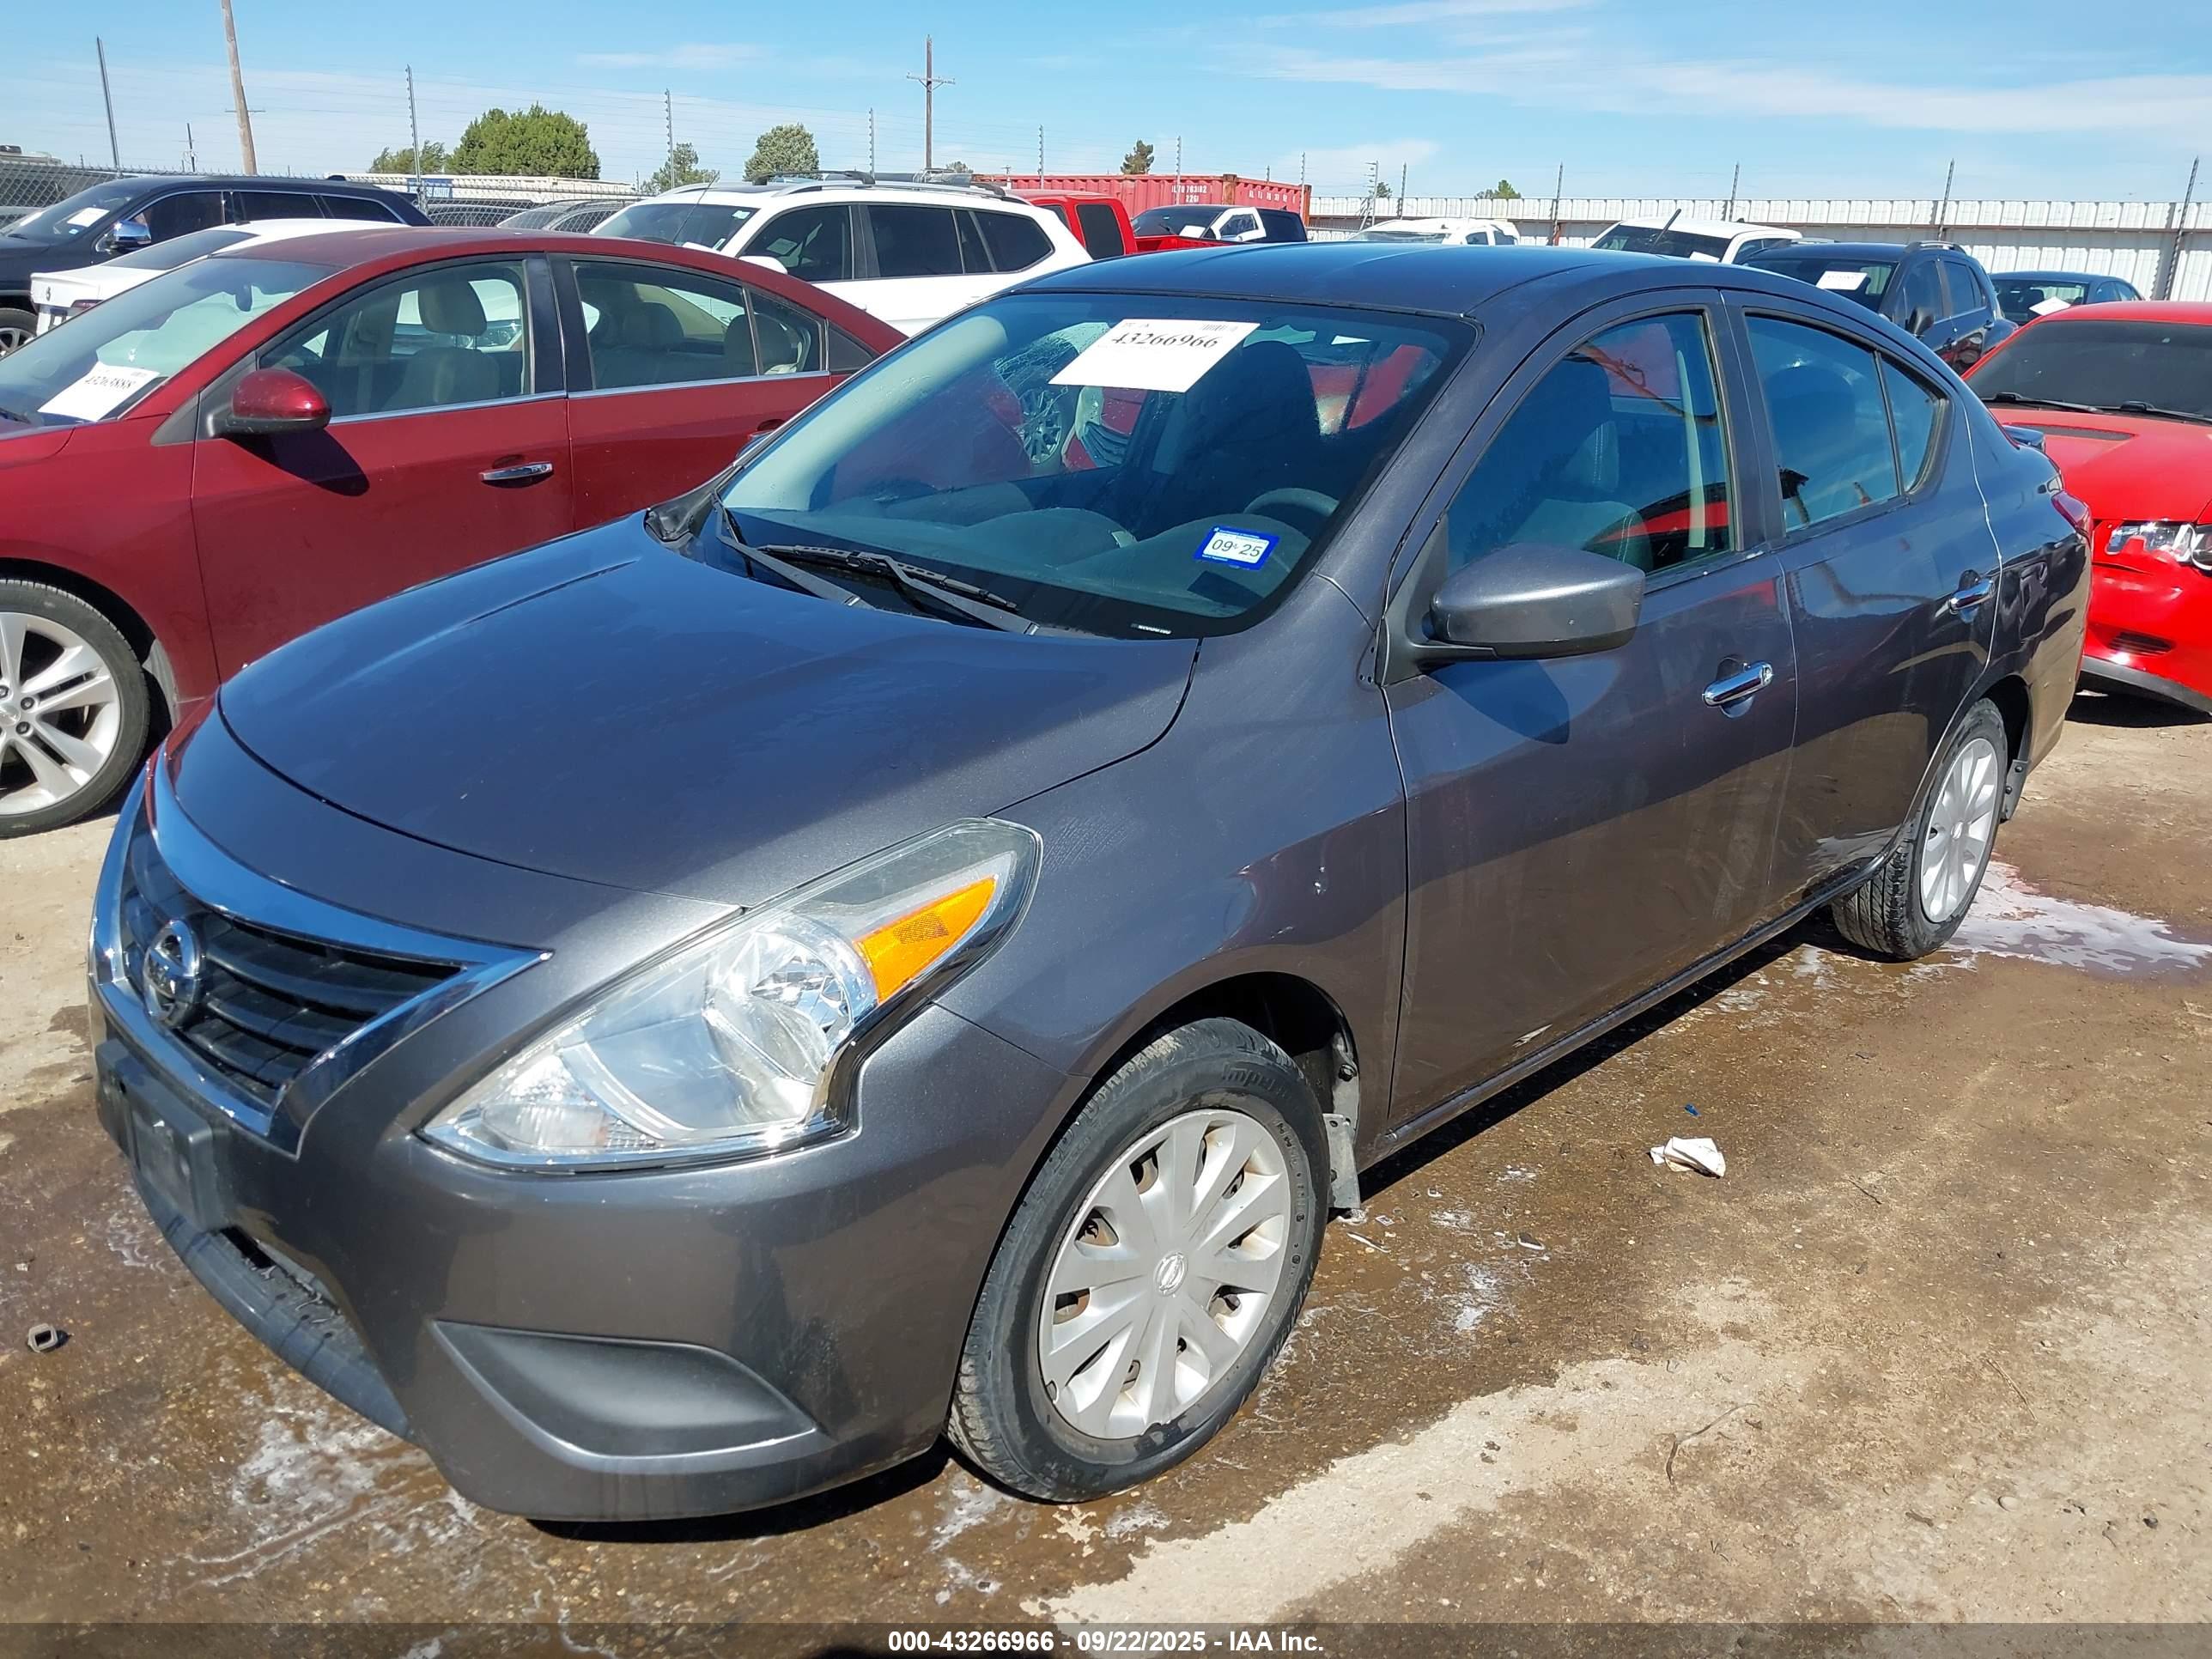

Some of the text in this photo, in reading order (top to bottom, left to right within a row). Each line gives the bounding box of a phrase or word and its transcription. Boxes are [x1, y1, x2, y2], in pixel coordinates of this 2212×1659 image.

[1111, 332, 1223, 349] 43266966
[1212, 539, 1263, 557] 09 25
